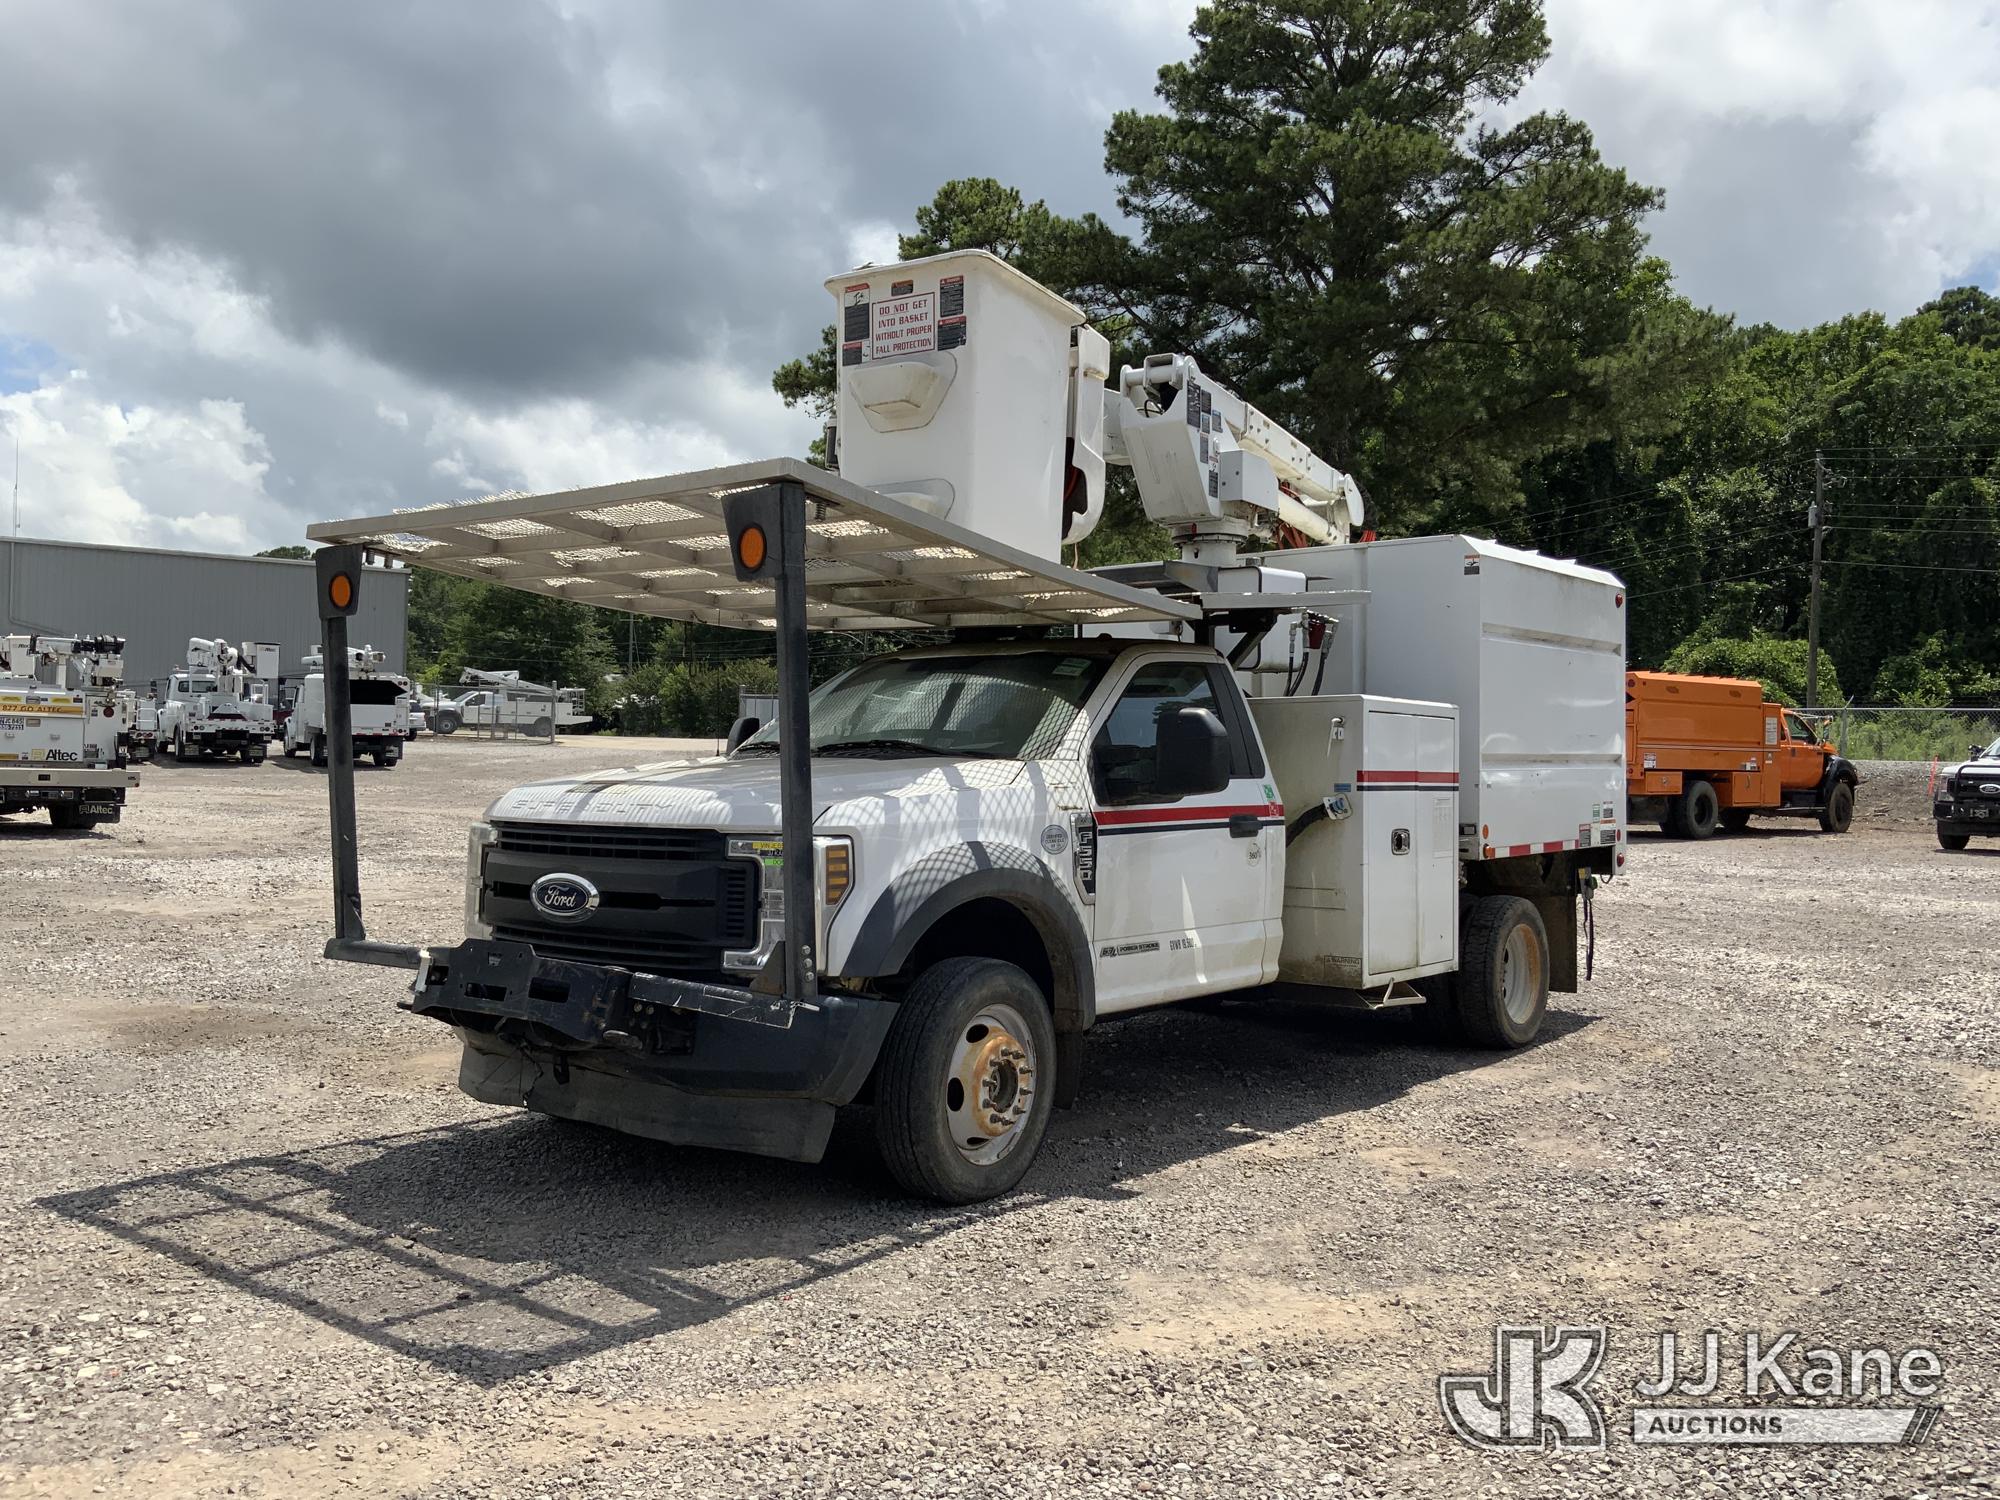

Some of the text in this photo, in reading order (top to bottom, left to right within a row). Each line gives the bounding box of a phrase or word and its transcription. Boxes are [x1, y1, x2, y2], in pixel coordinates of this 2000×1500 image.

[879, 300, 927, 315] DO NOT GET
[878, 312, 928, 328] INTO BASKET
[875, 325, 932, 341] WITHOUT PROPER
[875, 344, 890, 354] FALL
[892, 338, 932, 351] PROTECTION
[45, 749, 78, 761] Altec
[90, 805, 113, 815] Altec
[544, 884, 577, 908] Ford
[1119, 944, 1138, 952] POWER
